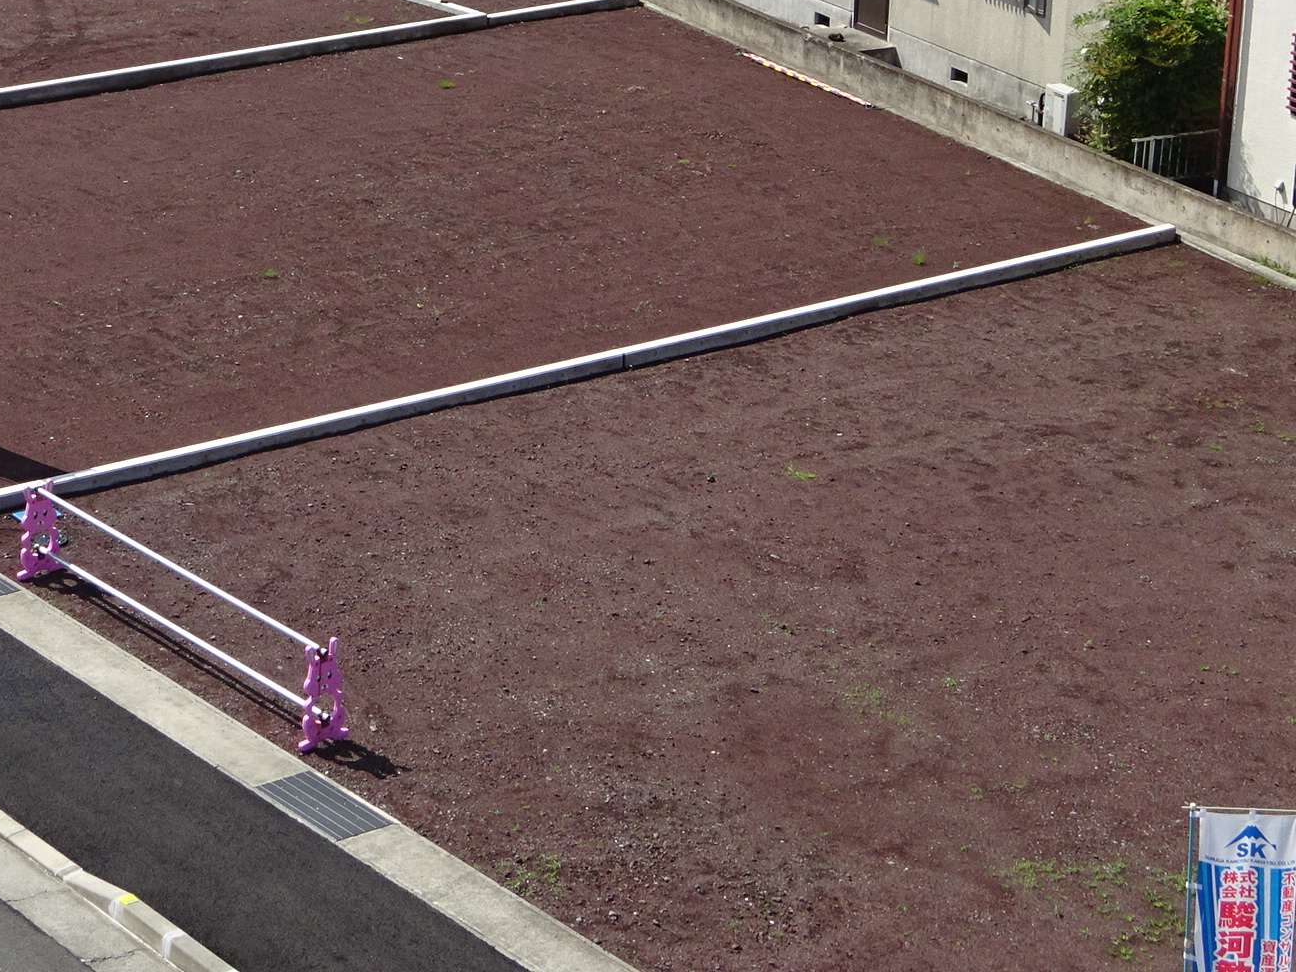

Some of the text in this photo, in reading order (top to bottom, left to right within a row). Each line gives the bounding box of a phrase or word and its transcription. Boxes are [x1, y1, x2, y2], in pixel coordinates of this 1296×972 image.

[1236, 842, 1267, 859] SK
[1279, 871, 1295, 972] 不動産コンサル
